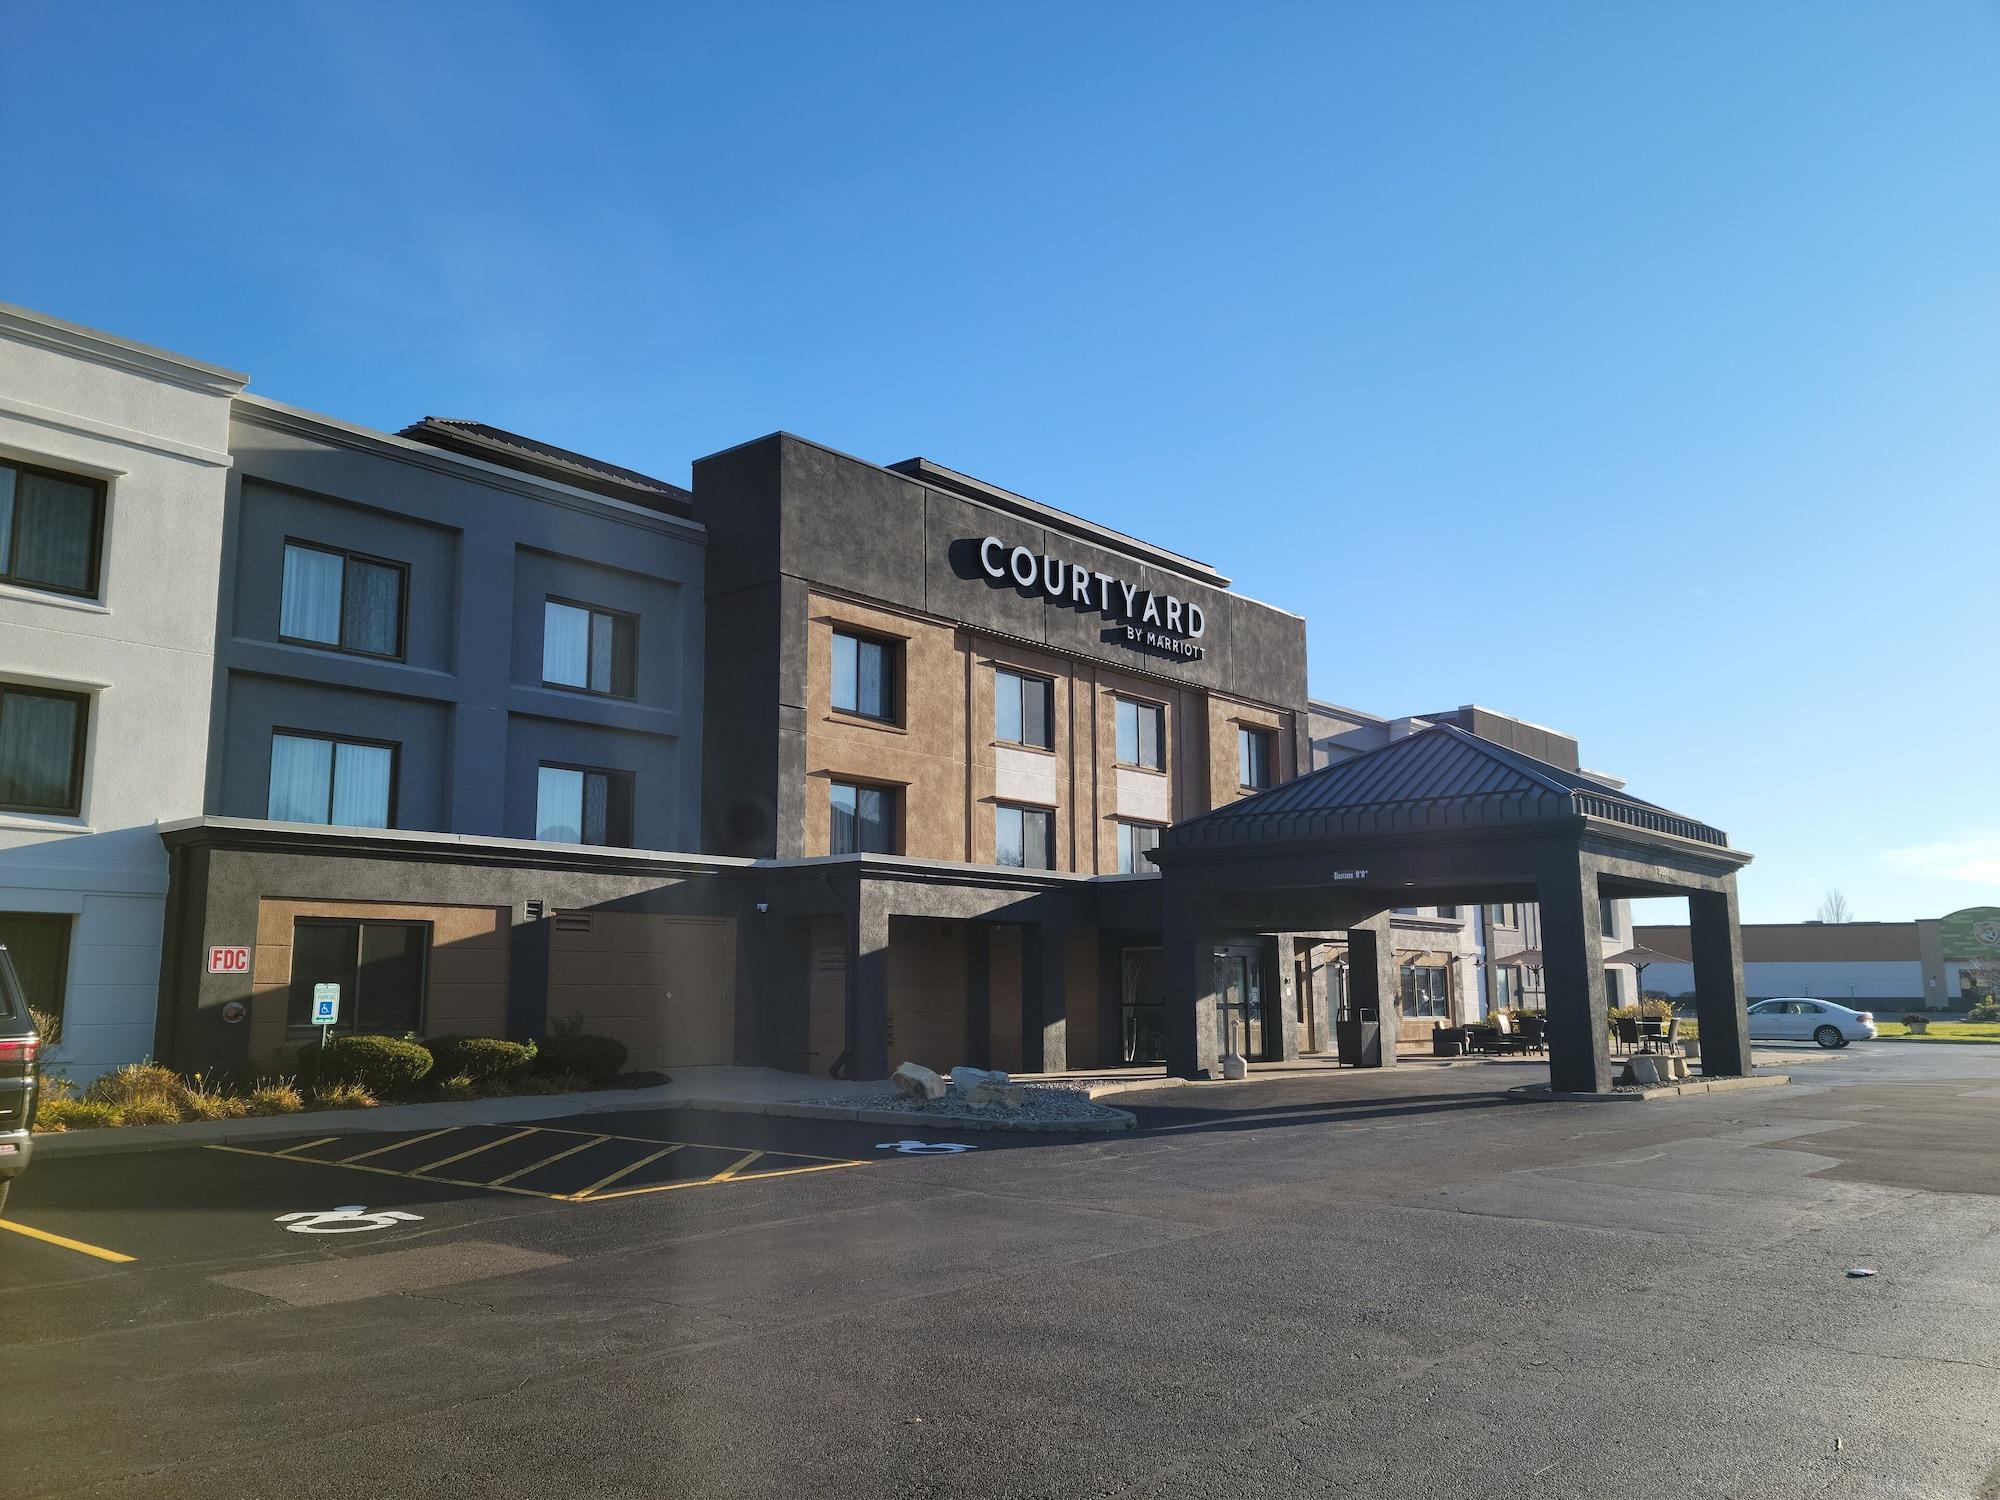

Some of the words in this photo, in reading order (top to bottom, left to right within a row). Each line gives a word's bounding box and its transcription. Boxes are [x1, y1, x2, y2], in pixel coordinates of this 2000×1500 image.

[980, 536, 1206, 638] COURTYARD
[1127, 626, 1142, 642] BY
[1147, 631, 1206, 660] MARRIOTT
[212, 949, 246, 970] FDC
